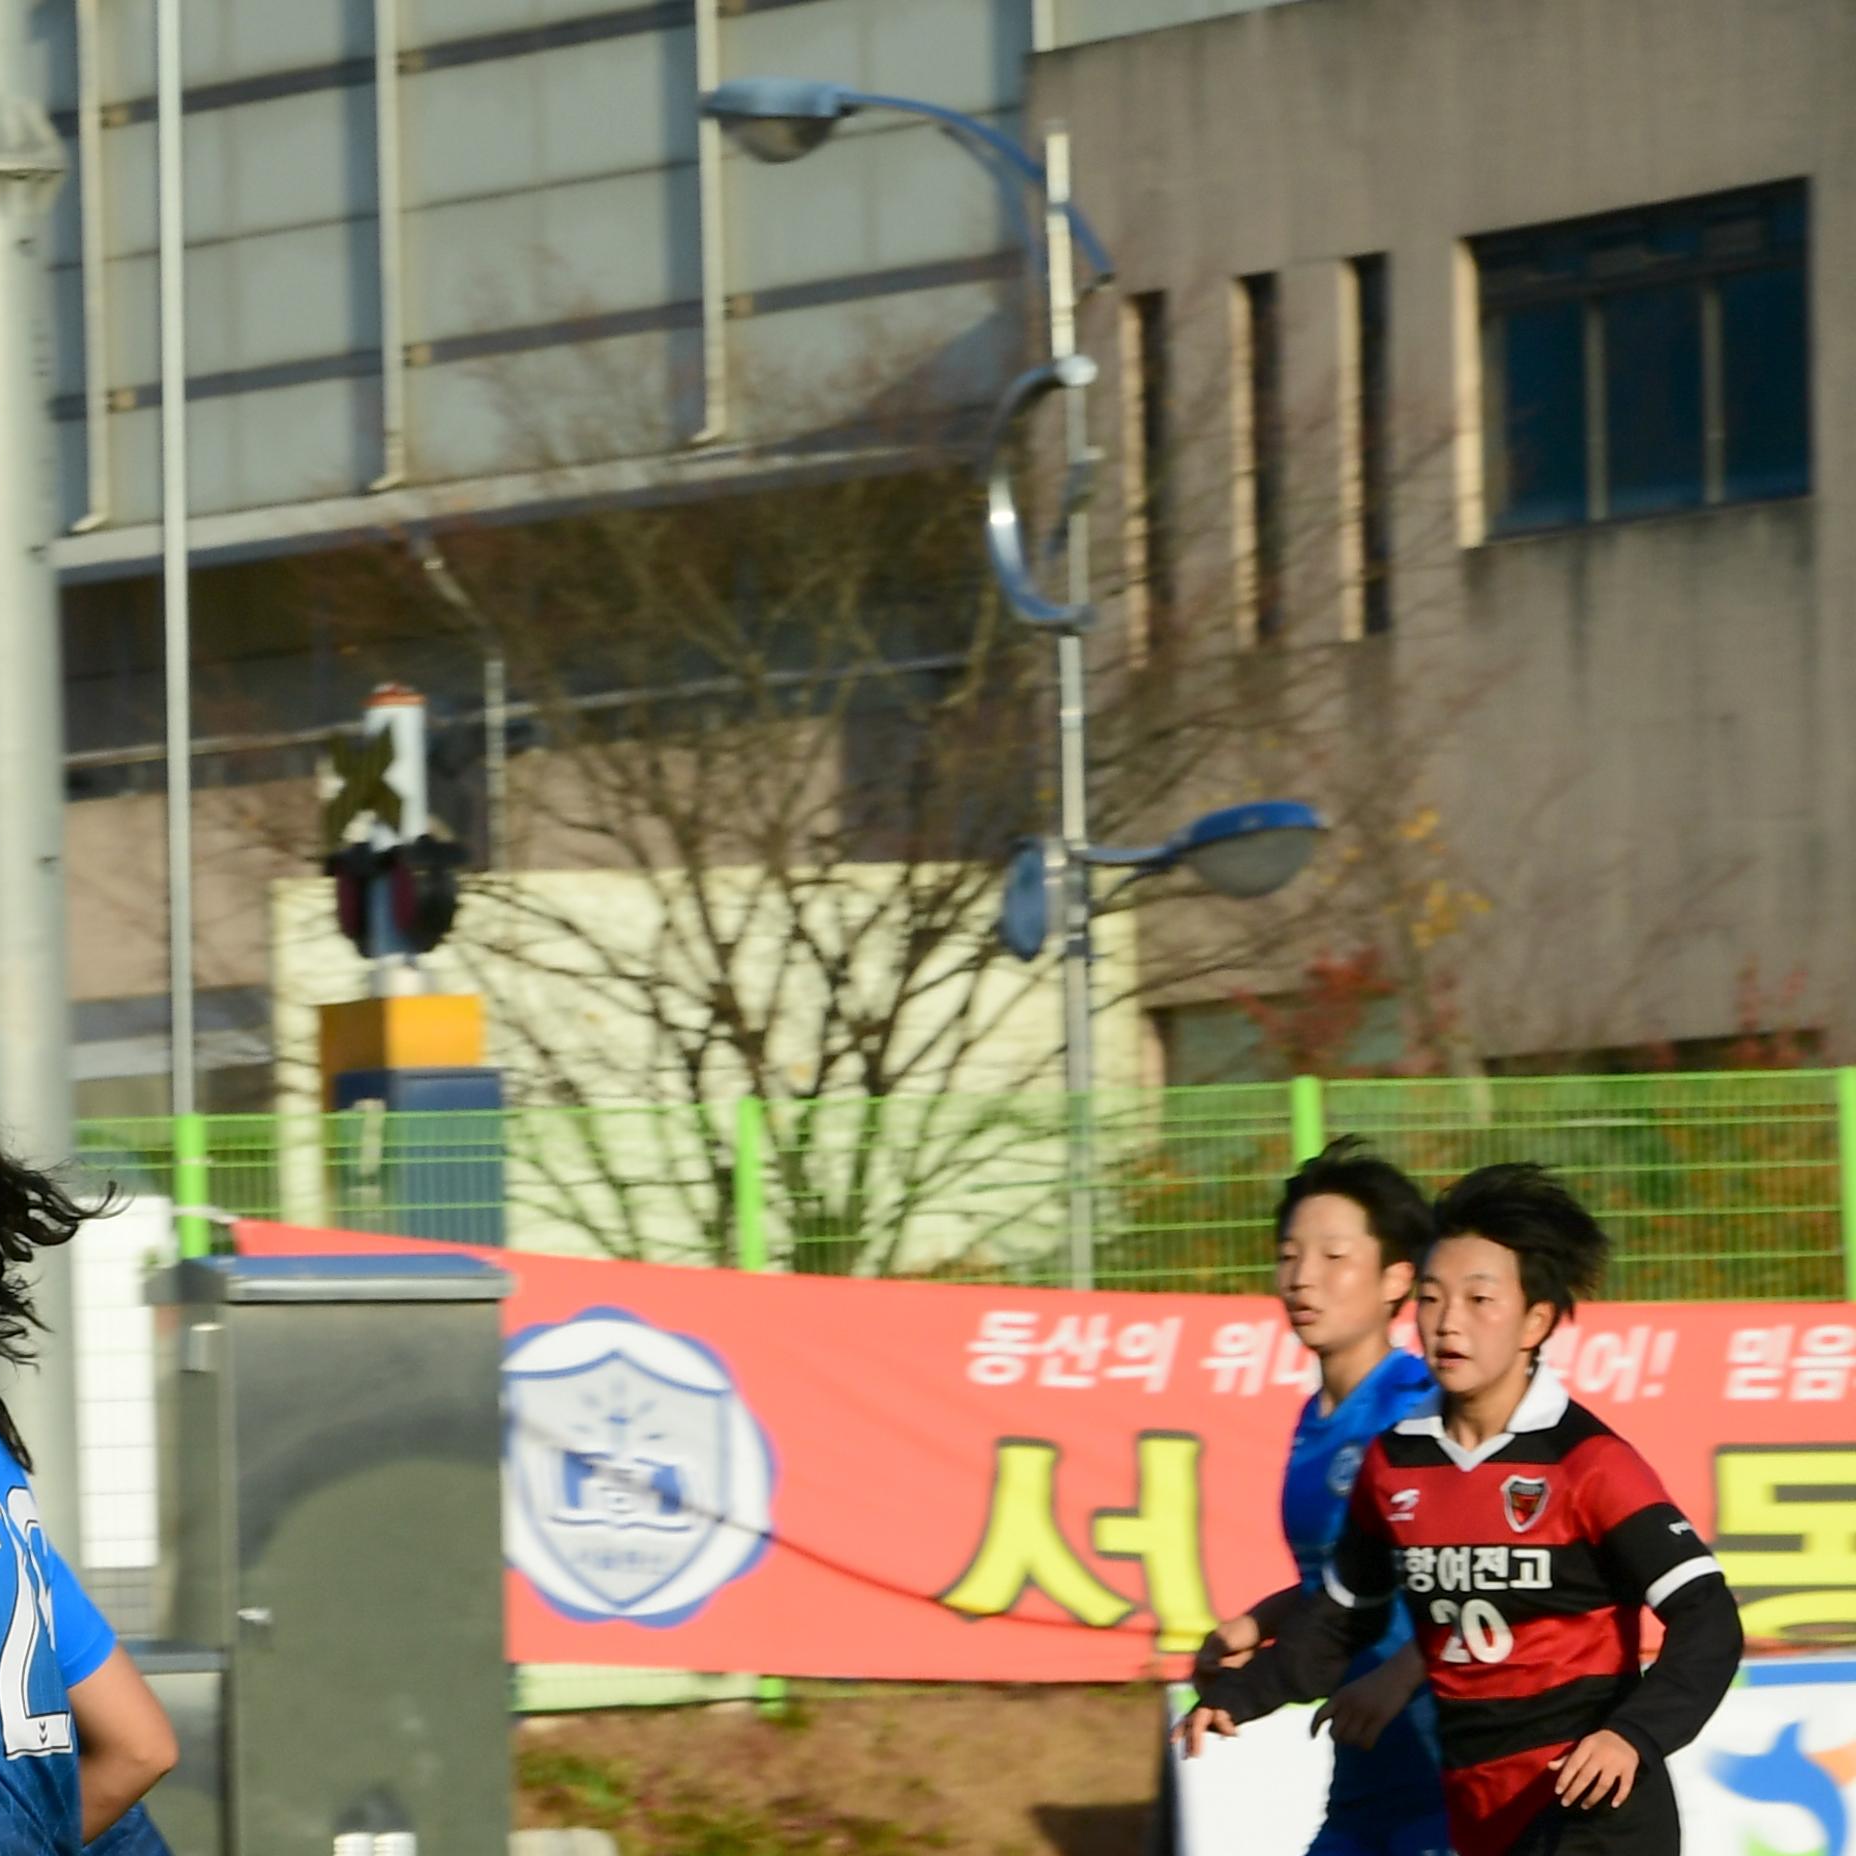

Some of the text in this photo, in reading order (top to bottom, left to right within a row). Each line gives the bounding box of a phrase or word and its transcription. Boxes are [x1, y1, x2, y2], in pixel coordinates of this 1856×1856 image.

[965, 1310, 1185, 1394] 동산의
[1540, 1325, 1677, 1401] 어!
[1724, 1325, 1856, 1400] 믿음
[1396, 1546, 1553, 1593] 항여전고
[1429, 1598, 1515, 1664] 20
